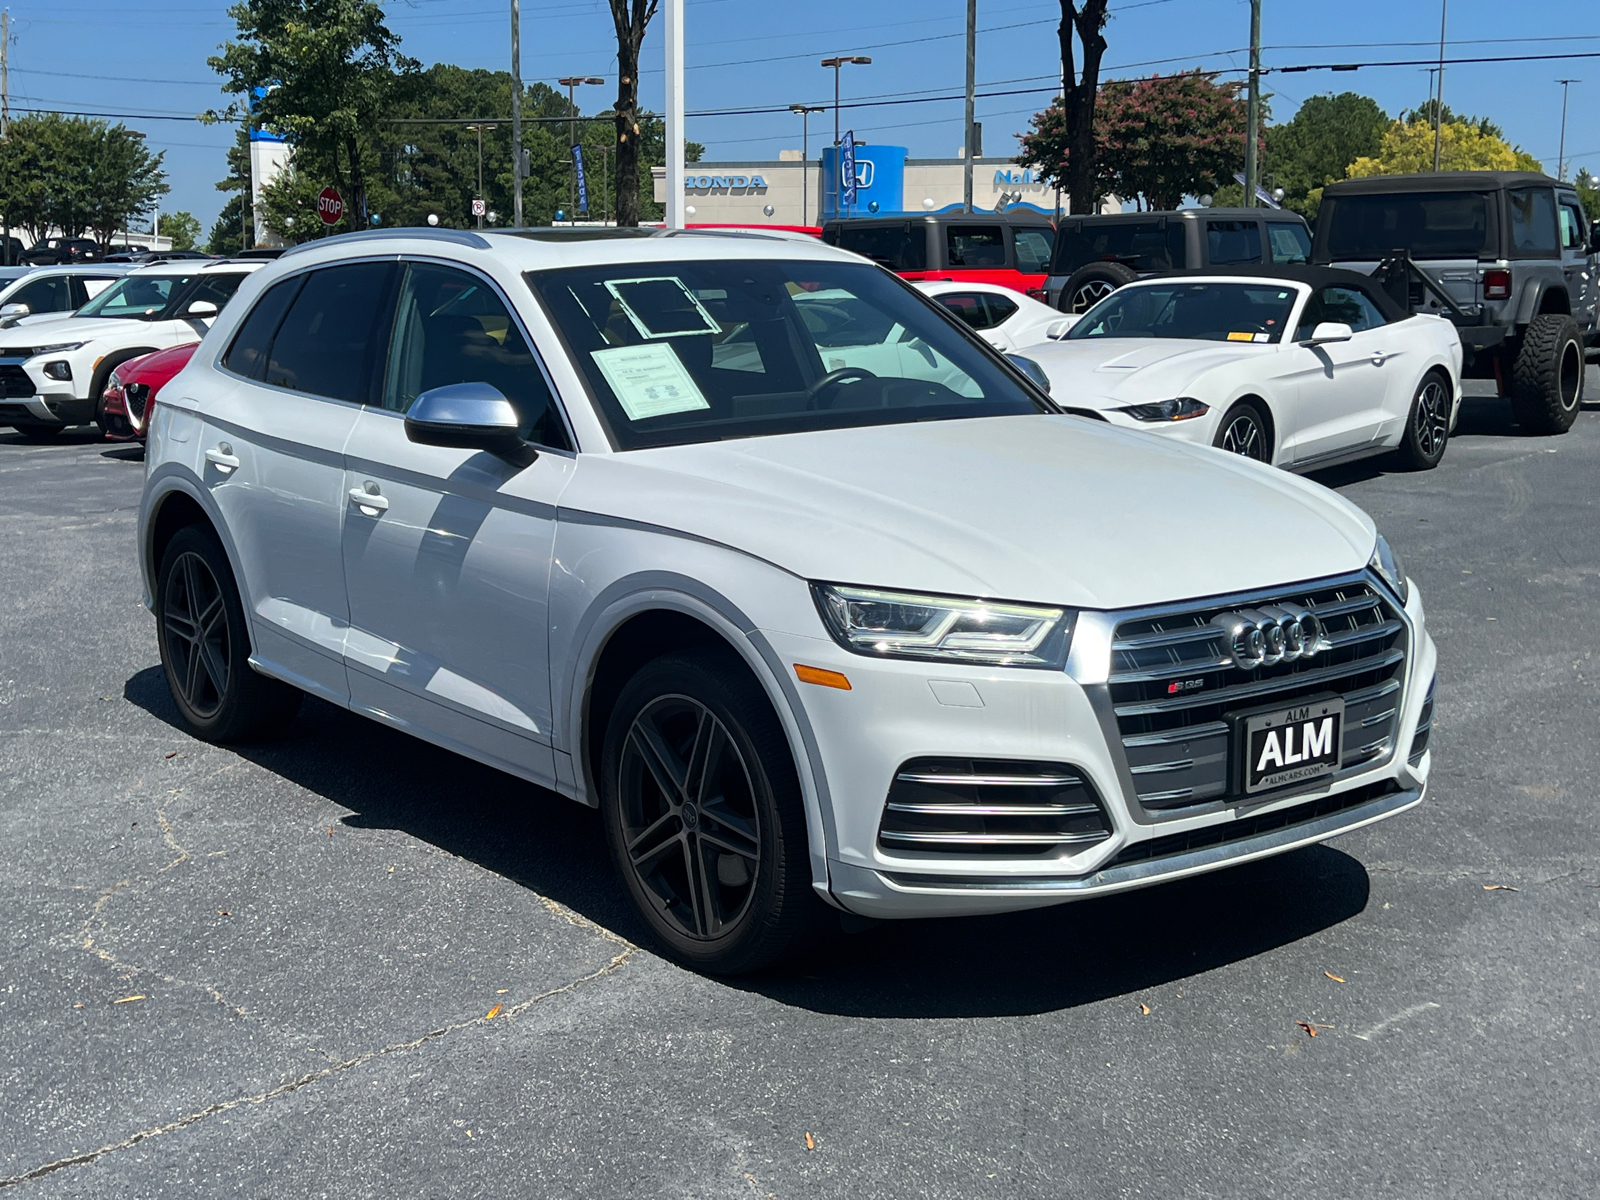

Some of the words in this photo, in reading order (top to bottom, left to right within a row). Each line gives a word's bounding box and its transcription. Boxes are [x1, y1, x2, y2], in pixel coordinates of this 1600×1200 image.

[319, 196, 341, 215] STOP
[1285, 707, 1310, 723] ALM
[1256, 717, 1333, 771] ALM
[1269, 766, 1320, 785] ALMCARS.COM
